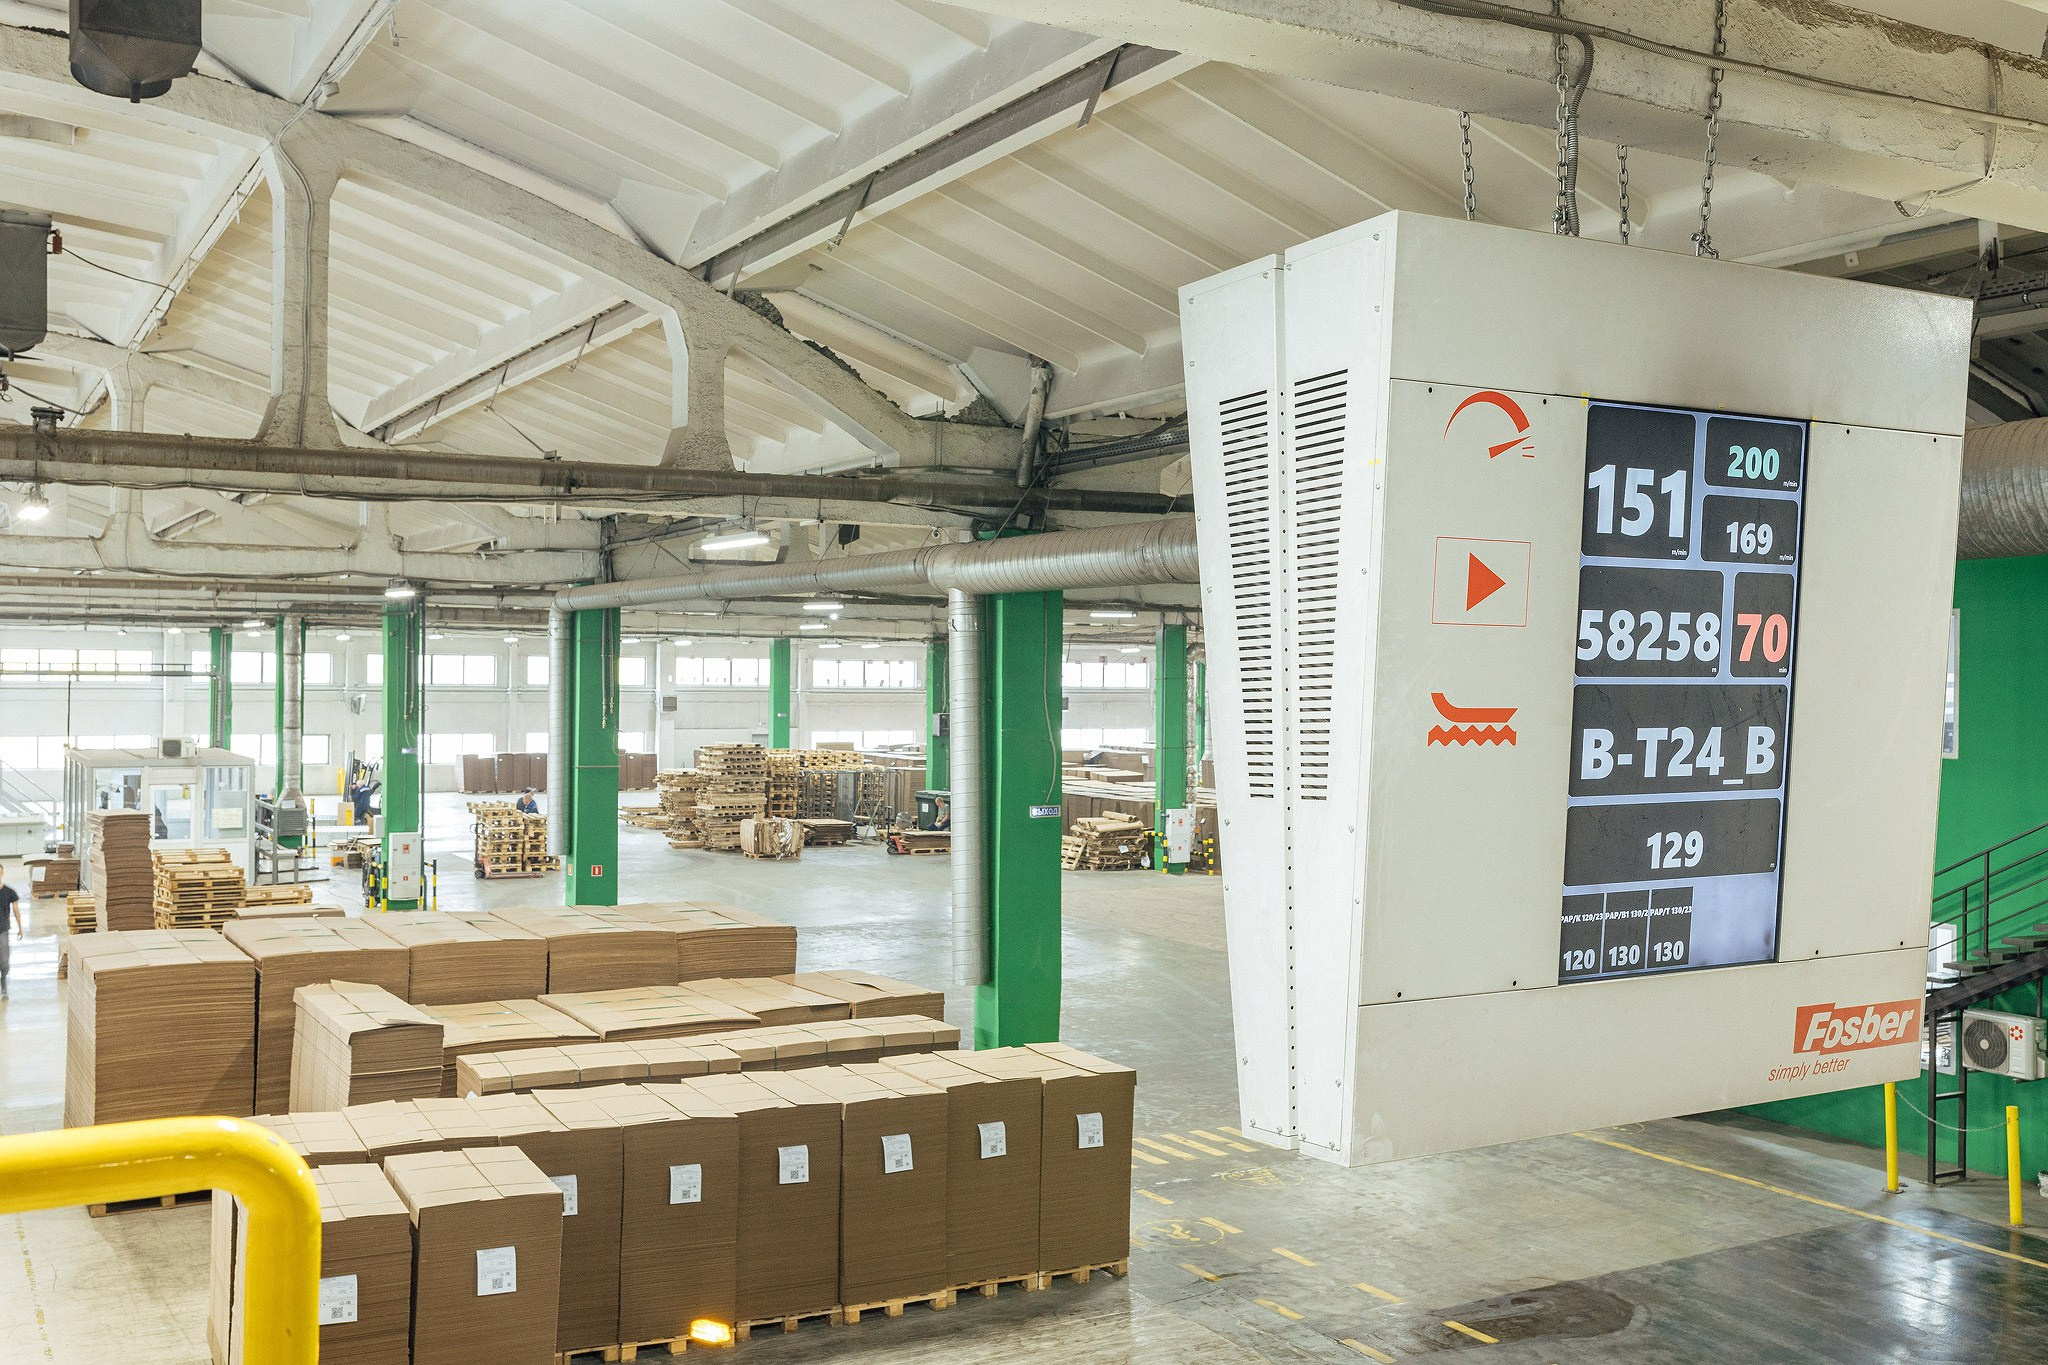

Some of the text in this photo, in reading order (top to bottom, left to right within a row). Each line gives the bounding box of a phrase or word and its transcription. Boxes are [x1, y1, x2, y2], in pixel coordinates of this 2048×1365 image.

[1726, 445, 1780, 480] 200
[1588, 464, 1687, 538] 151
[1671, 548, 1687, 556] m/min
[1726, 521, 1773, 555] 169
[1779, 553, 1794, 561] m/min
[1577, 609, 1721, 662] 58258
[1737, 613, 1788, 663] 70
[1580, 726, 1776, 785] B-T24_B
[1646, 830, 1704, 869] 129
[1650, 907, 1671, 916] PAP/T
[1563, 948, 1596, 971] 120
[1608, 944, 1641, 967] 130
[1653, 940, 1685, 962] 130
[1802, 1005, 1915, 1051] Fosber
[1768, 1058, 1851, 1083] simply better
